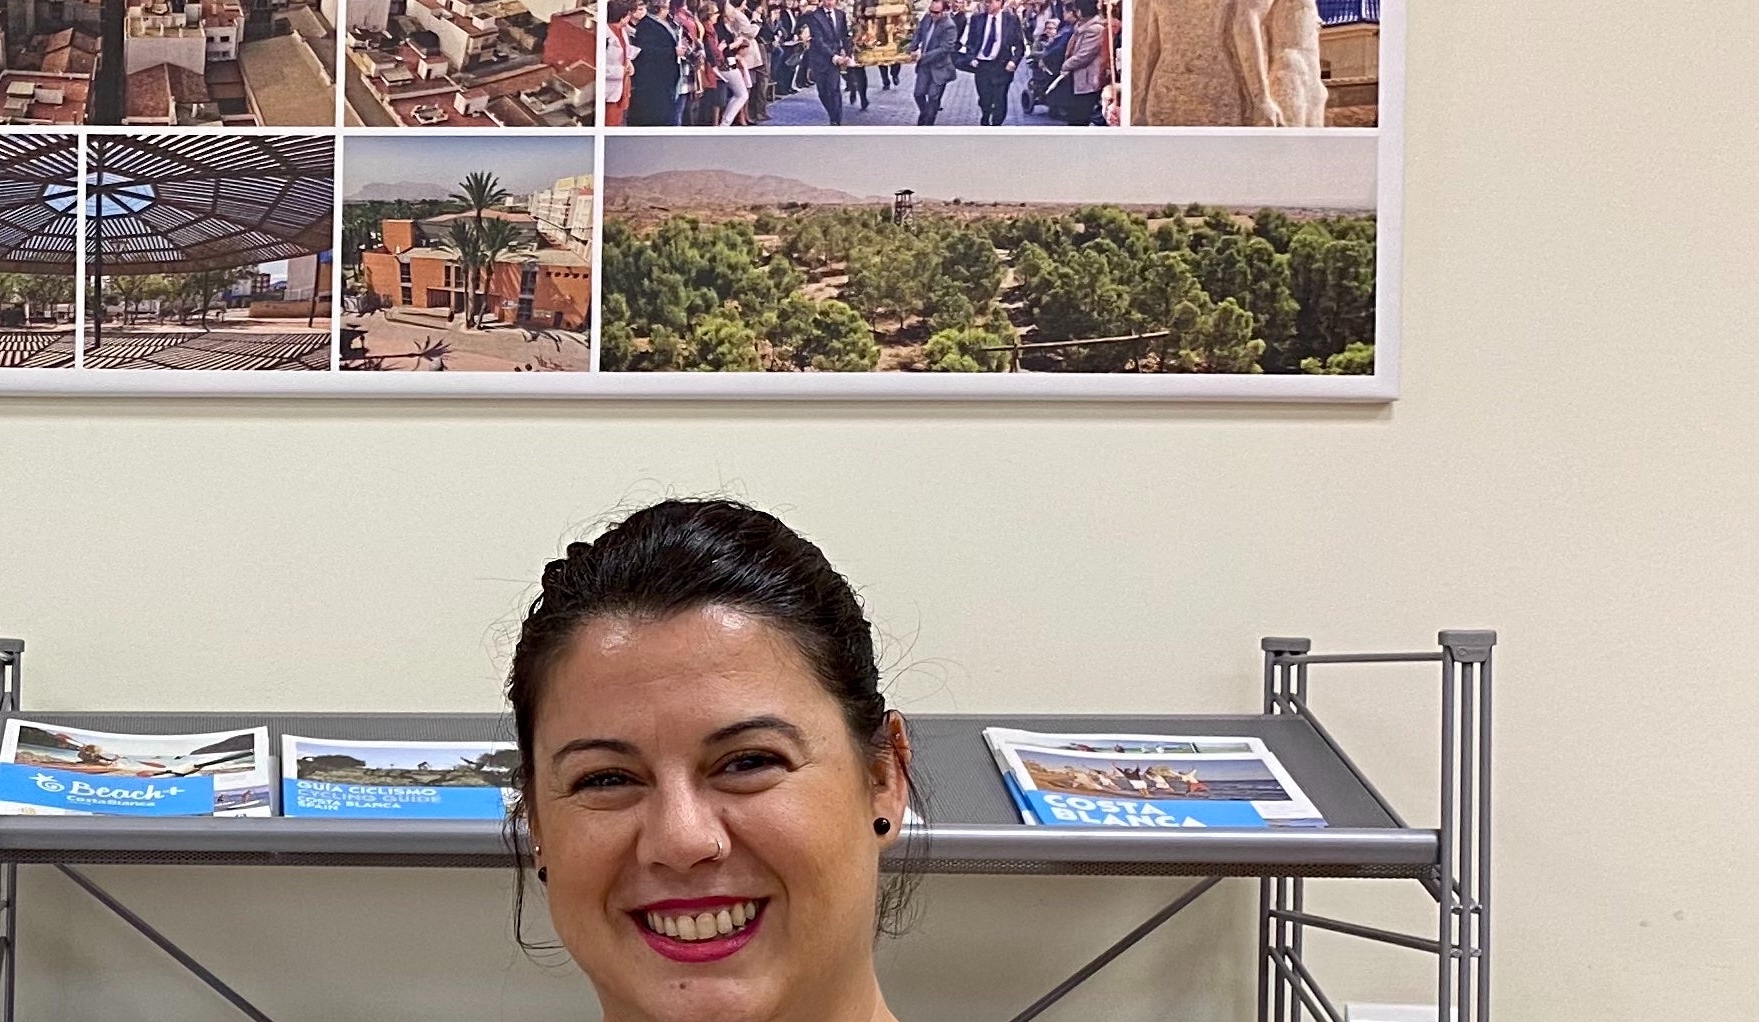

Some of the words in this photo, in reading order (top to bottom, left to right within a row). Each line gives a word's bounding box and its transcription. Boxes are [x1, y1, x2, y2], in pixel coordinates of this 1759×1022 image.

[69, 780, 185, 799] Beach+
[297, 782, 342, 793] GUÍA
[349, 786, 437, 796] CICLISMO
[298, 789, 377, 802] CYCLING
[383, 794, 440, 803] GUIDE
[346, 801, 401, 809] BLANCA
[1044, 794, 1167, 816] COSTA
[1051, 807, 1207, 827] BLANCA
